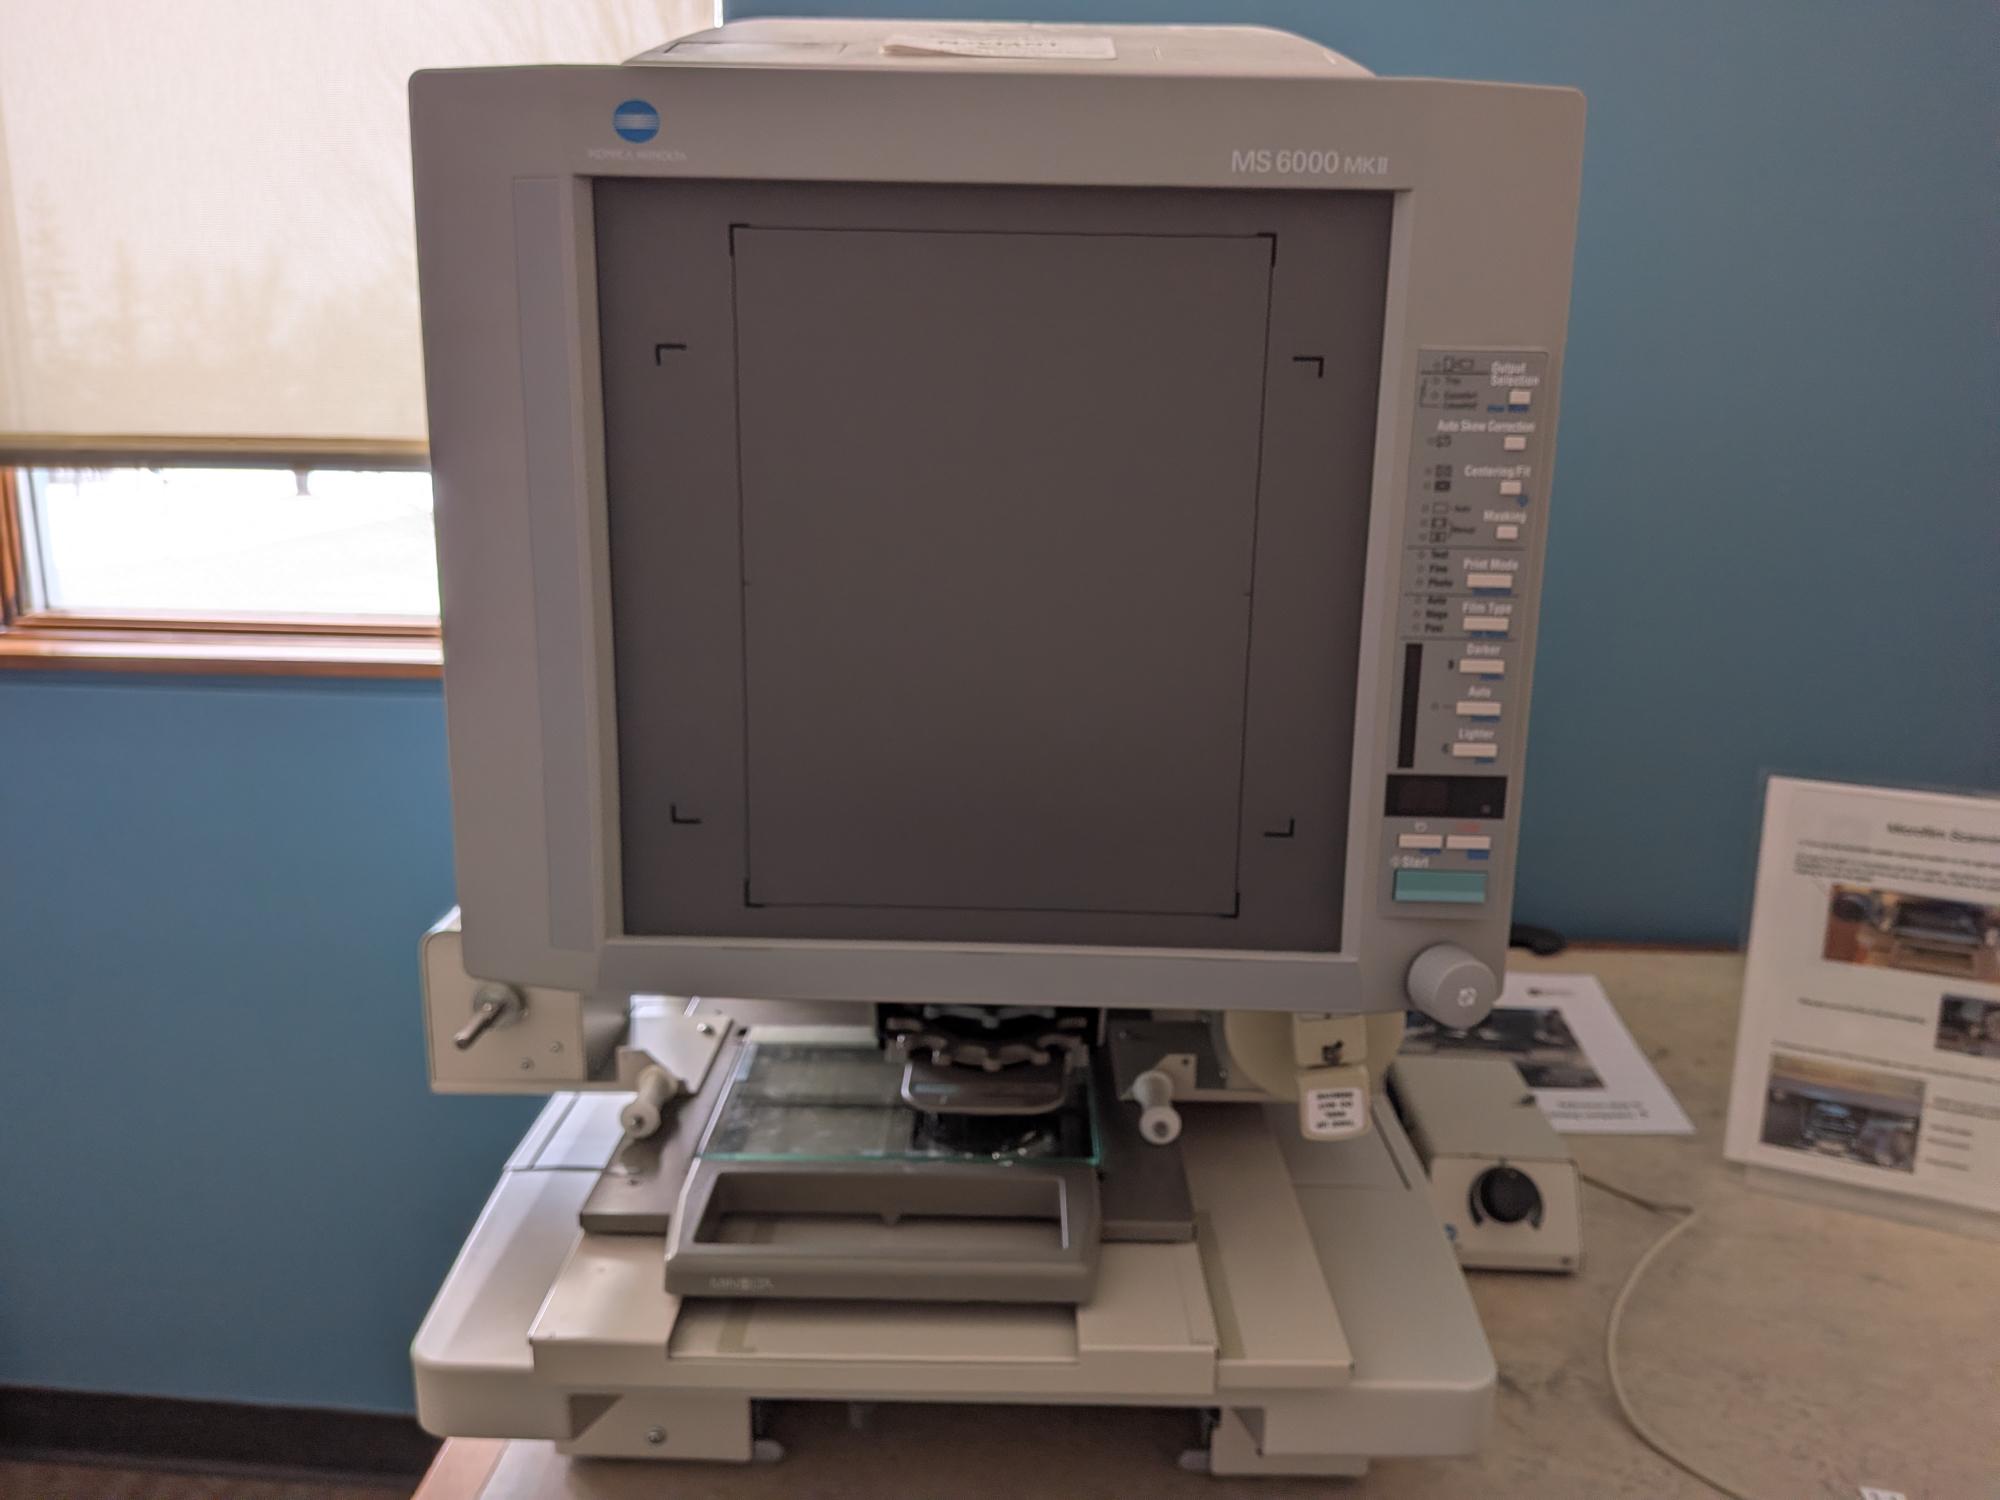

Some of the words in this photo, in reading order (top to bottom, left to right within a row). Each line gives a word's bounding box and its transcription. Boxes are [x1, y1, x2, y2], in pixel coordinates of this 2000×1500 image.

[1231, 150, 1272, 173] MS
[1276, 150, 1339, 174] 6000
[1437, 419, 1460, 432] Auto
[1487, 420, 1536, 432] Correction
[1463, 557, 1489, 570] Print
[1490, 558, 1519, 571] Mode
[1466, 643, 1501, 656] Darker
[1468, 685, 1492, 698] Auto
[1458, 728, 1495, 742] Lighter
[1402, 857, 1429, 869] Start
